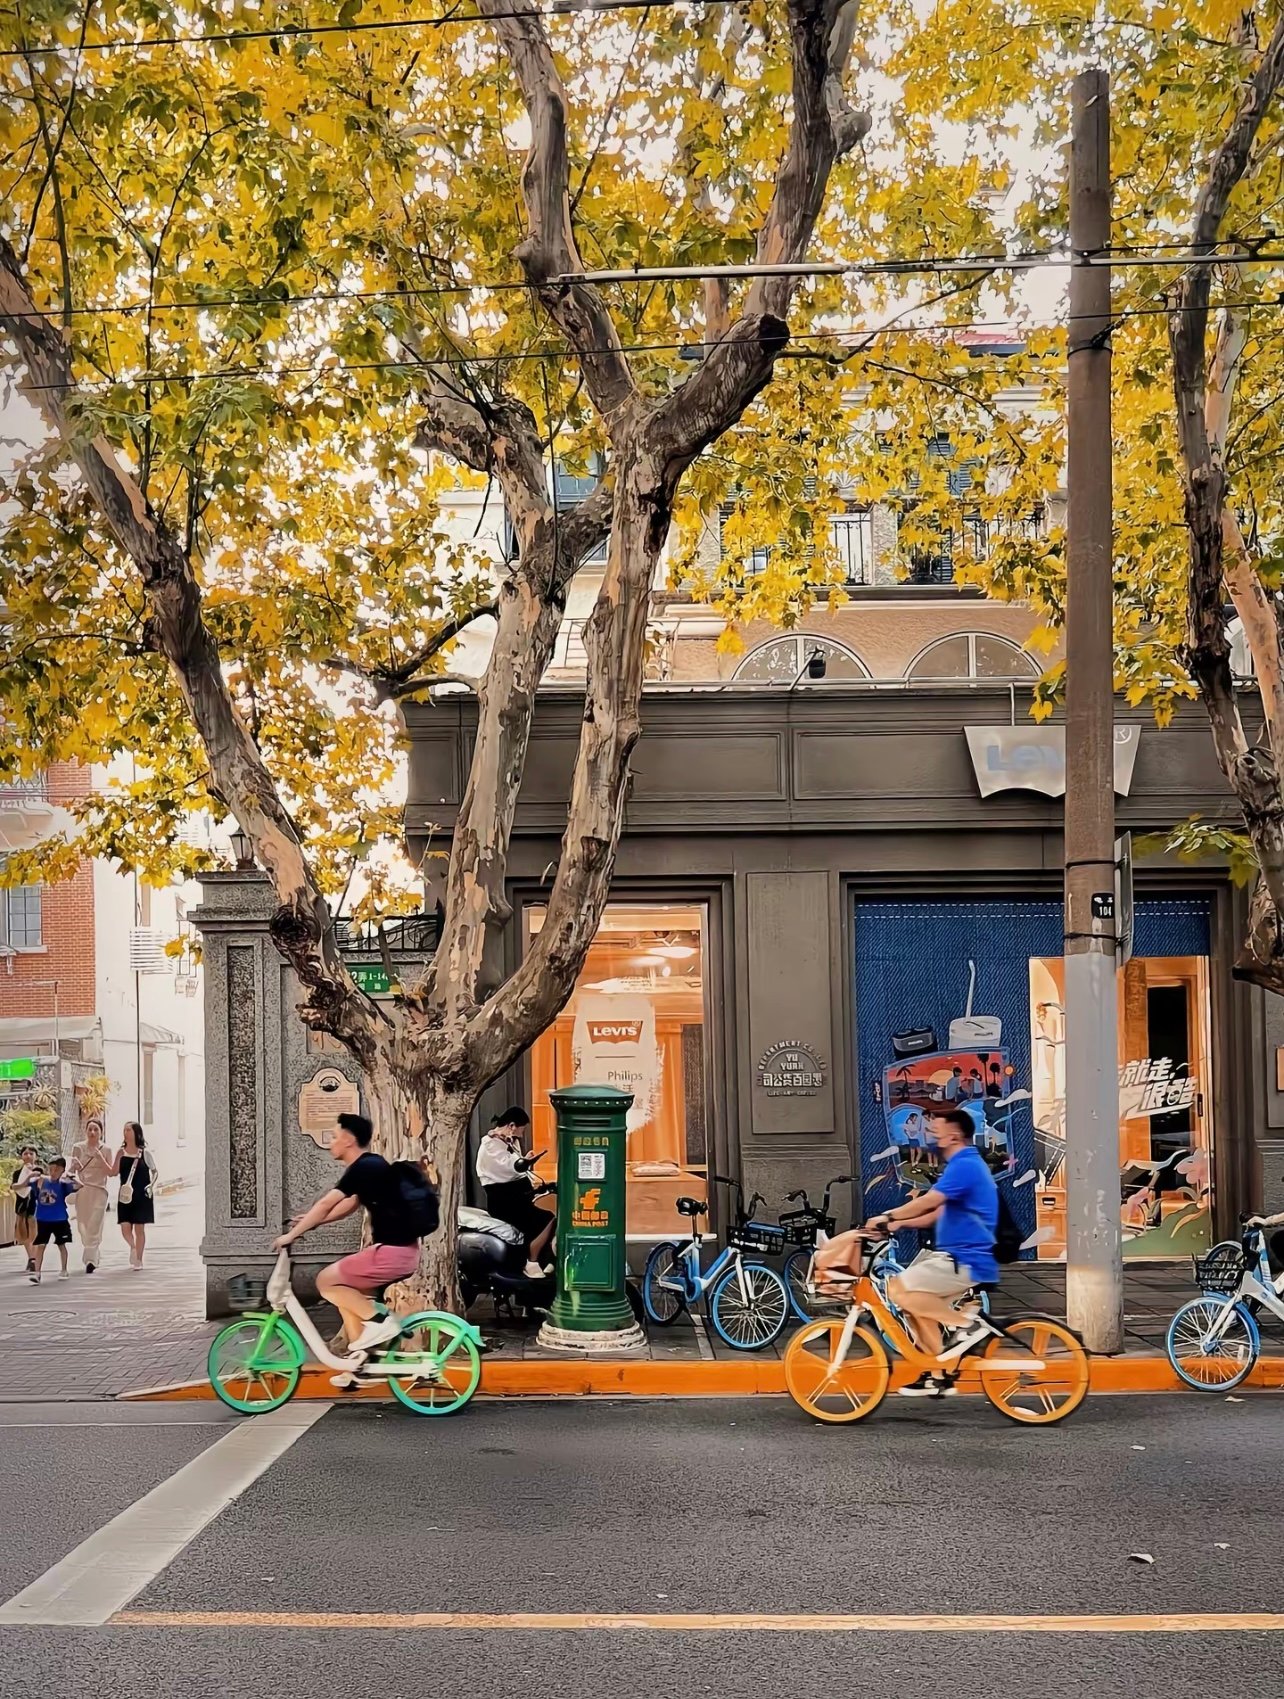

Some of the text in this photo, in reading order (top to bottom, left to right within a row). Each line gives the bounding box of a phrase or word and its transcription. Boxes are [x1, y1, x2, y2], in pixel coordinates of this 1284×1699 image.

[786, 1053, 798, 1062] YU
[607, 1070, 643, 1083] Philips
[1139, 1076, 1198, 1110] 很酷
